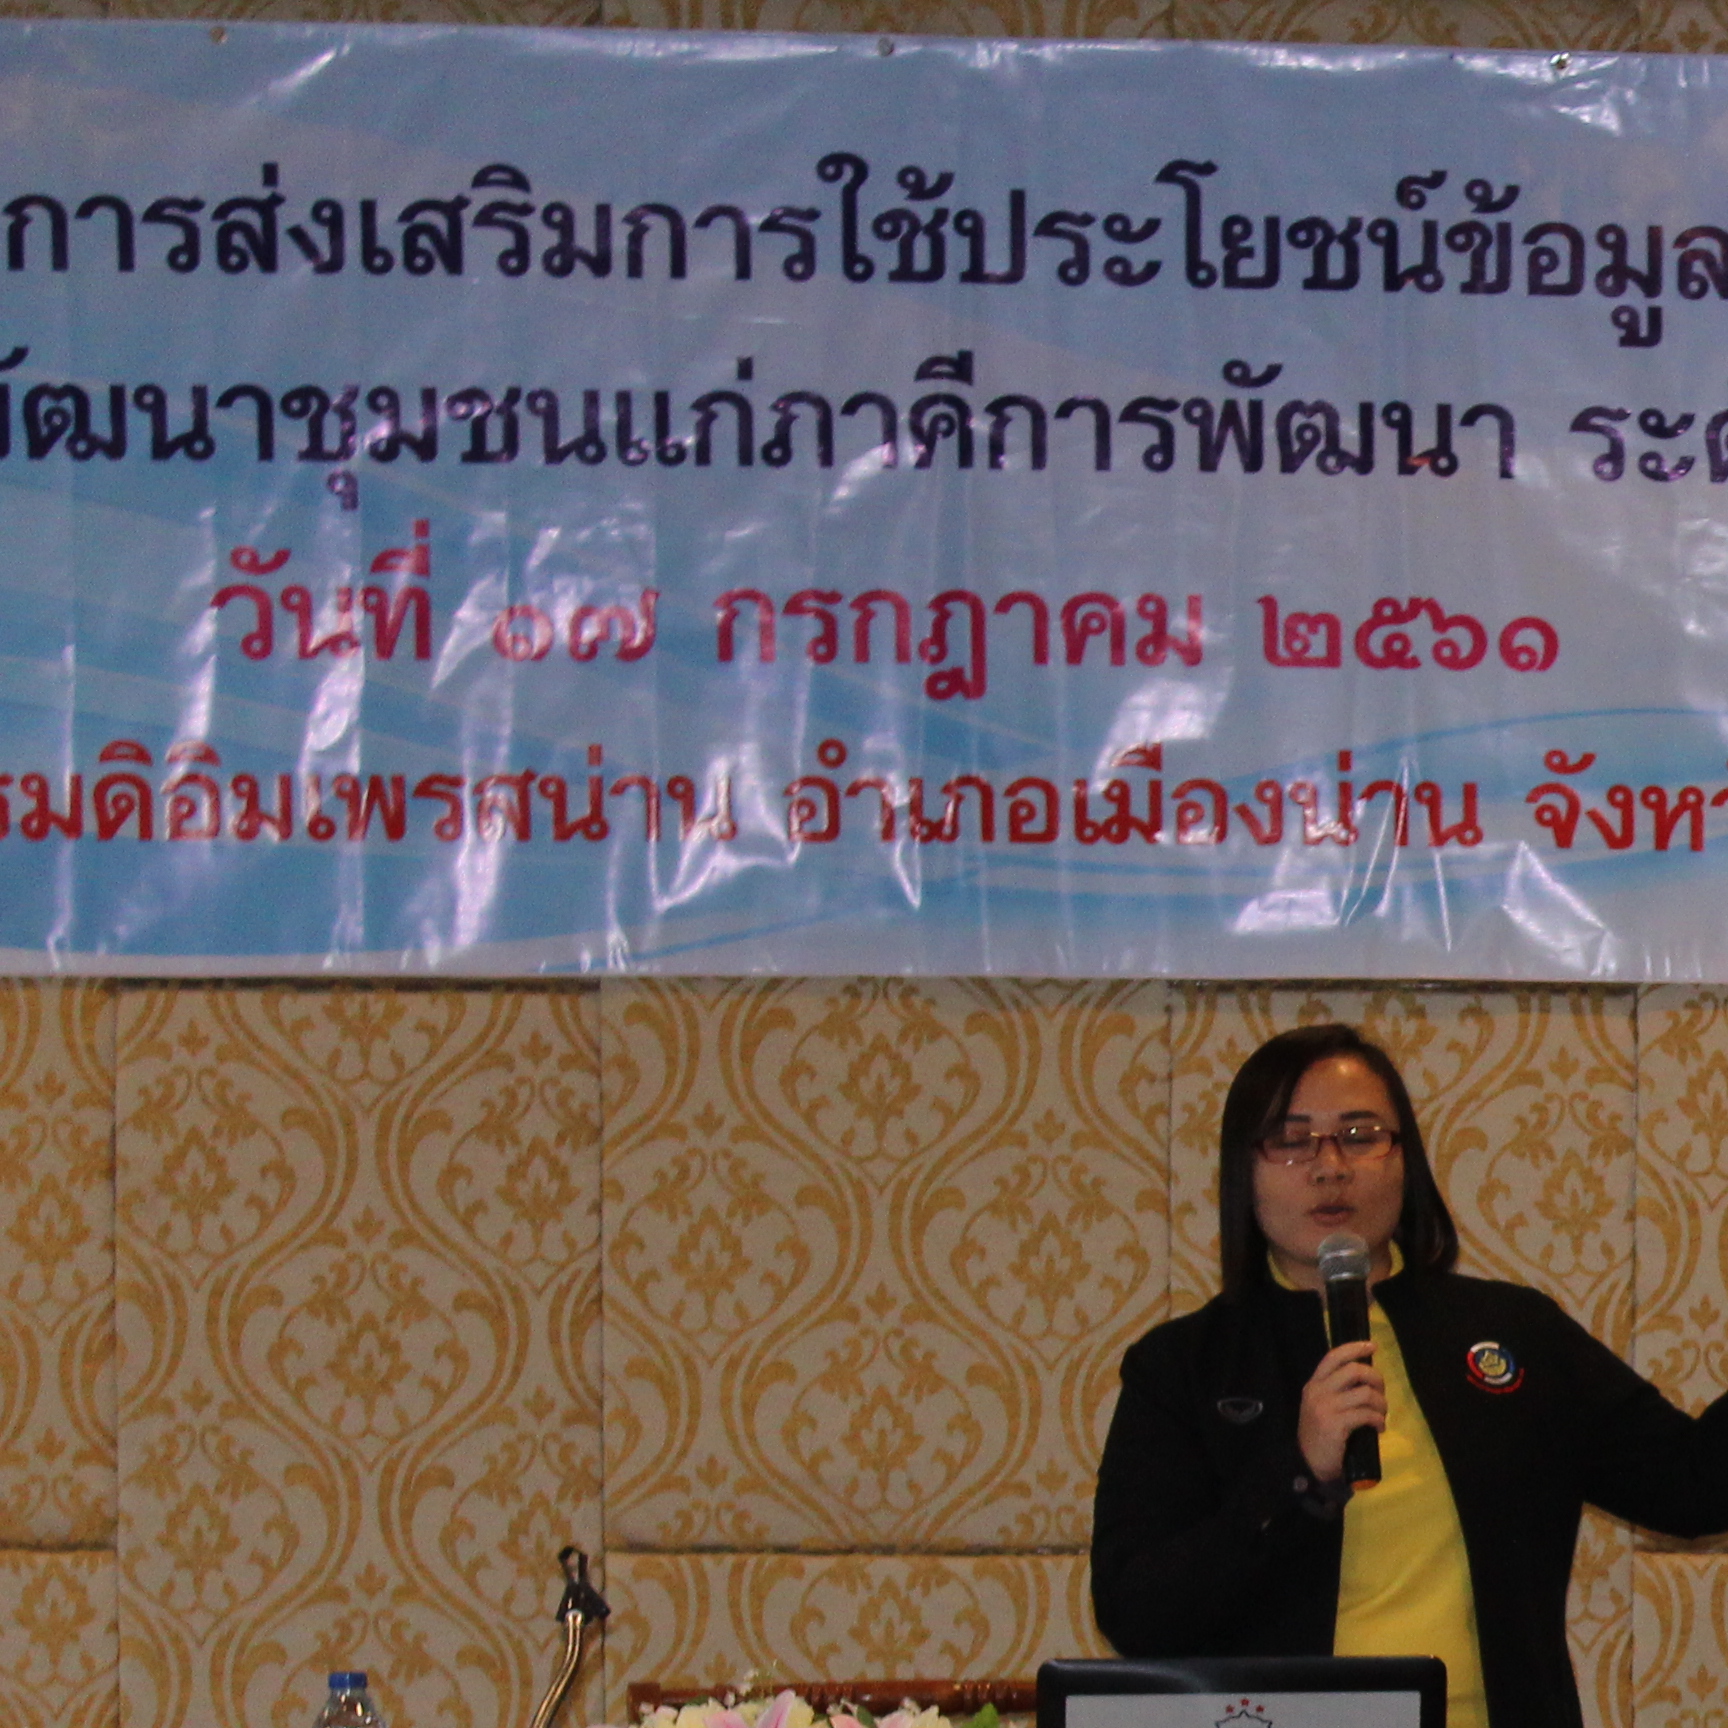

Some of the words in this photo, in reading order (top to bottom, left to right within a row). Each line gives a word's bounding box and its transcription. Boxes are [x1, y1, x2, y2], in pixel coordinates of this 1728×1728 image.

[0, 346, 1518, 512] ฒนาชุมชนแก่ภาคีการพัฒนา
[209, 518, 433, 662] วันที่
[714, 586, 1205, 702] กรกฎาคม
[1257, 594, 1560, 672] ๒๕๖๑
[782, 738, 1484, 848] อำเภอเมืองน่าน
